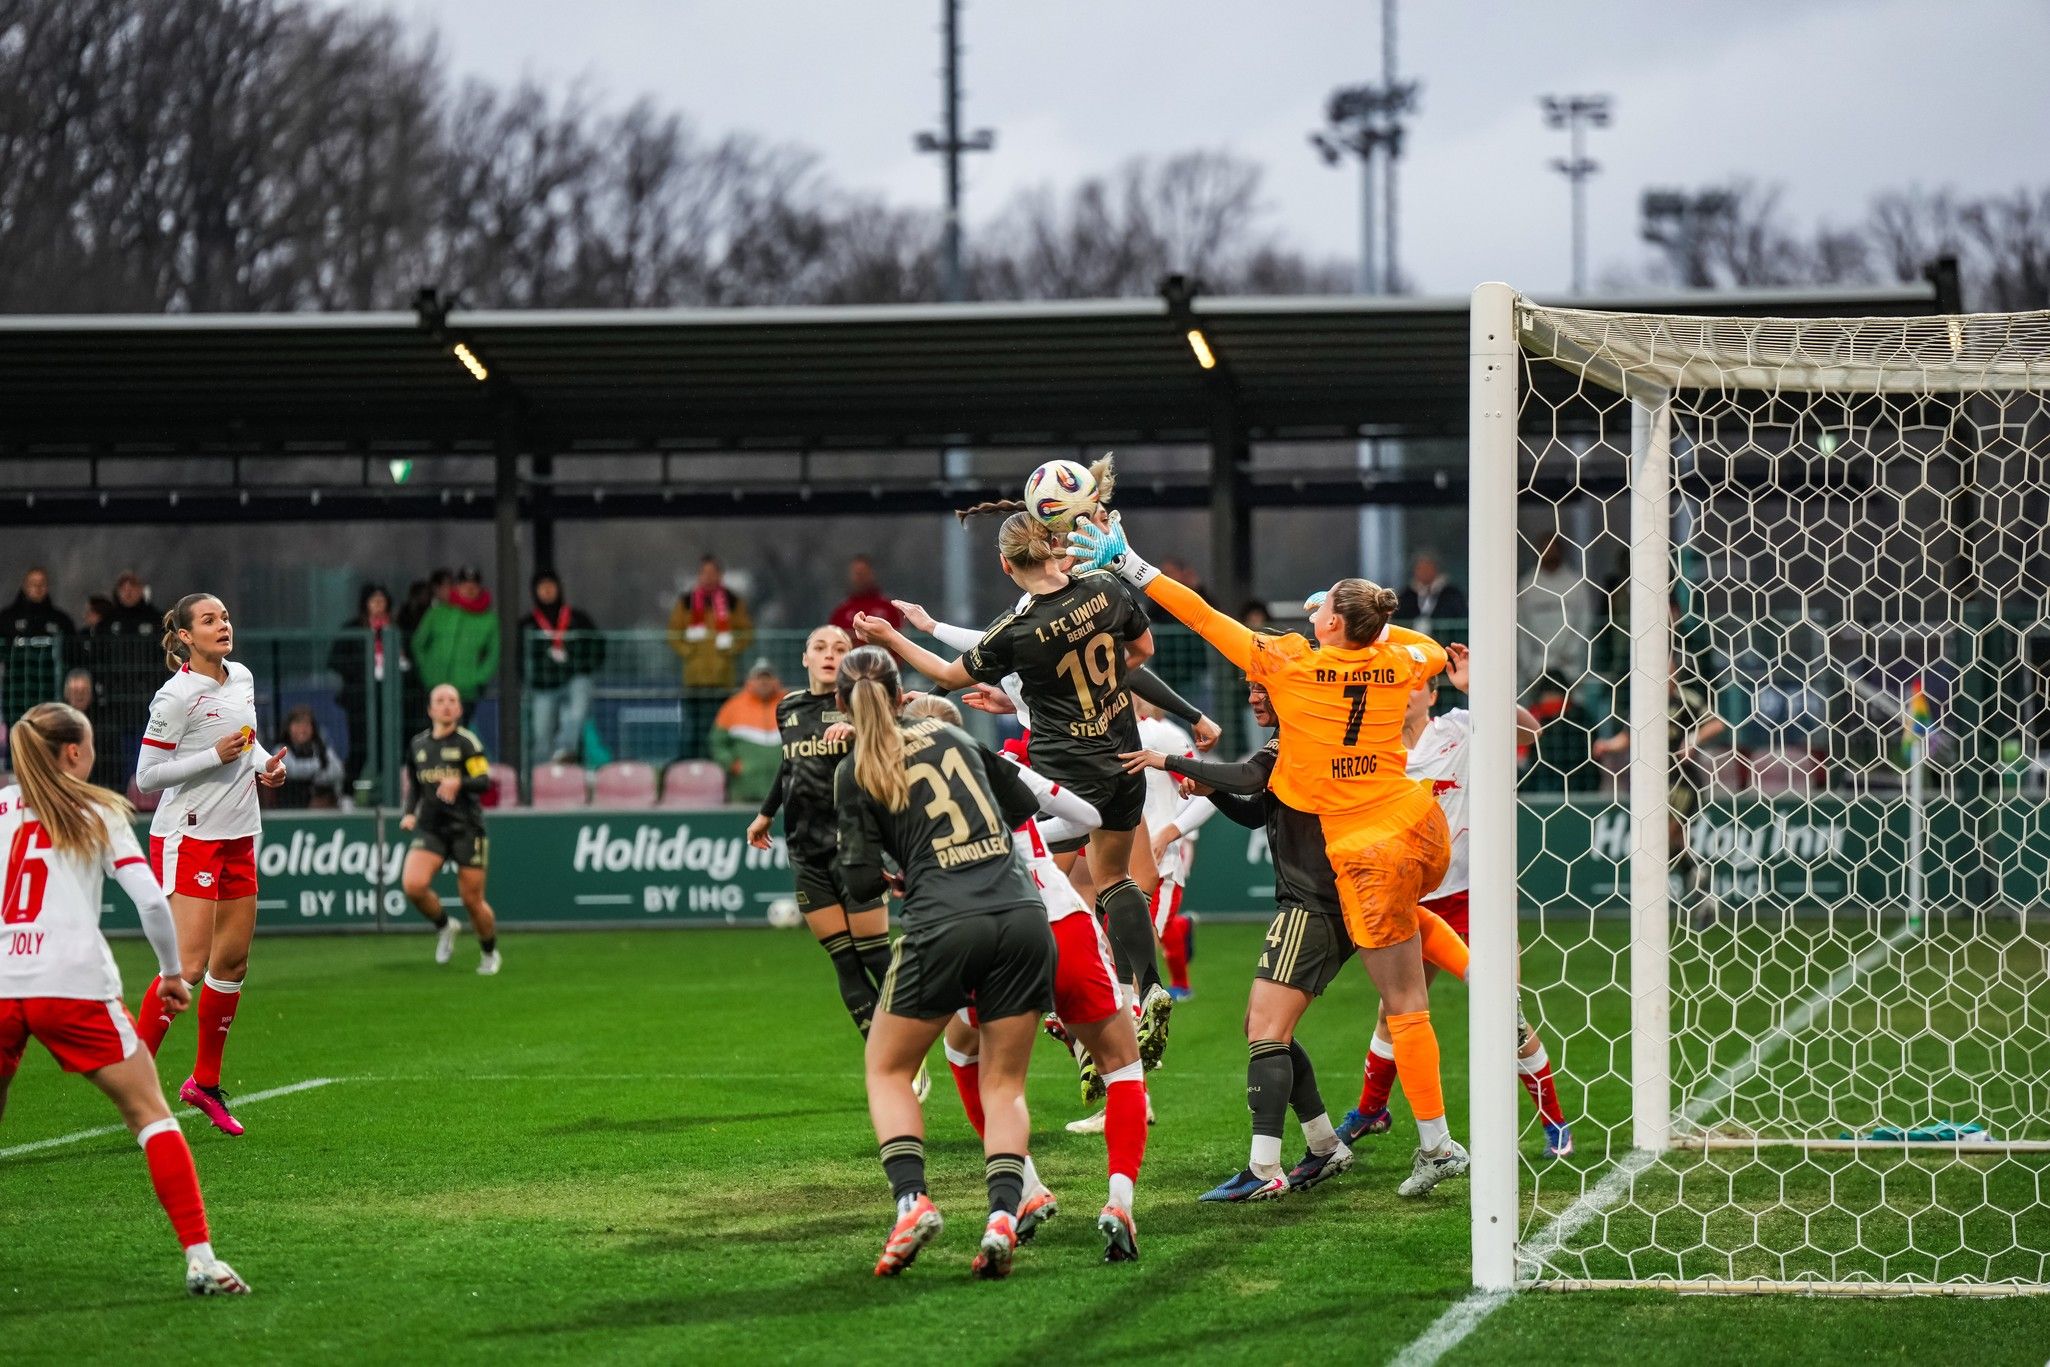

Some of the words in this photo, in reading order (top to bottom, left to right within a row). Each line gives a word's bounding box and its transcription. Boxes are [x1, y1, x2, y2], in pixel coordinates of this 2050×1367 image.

[1035, 627, 1050, 643] 1.
[1050, 617, 1071, 637] FC
[1069, 592, 1109, 626] UNION
[1066, 620, 1096, 643] BERLIN
[1056, 632, 1118, 720] 19
[1316, 669, 1337, 682] RB
[1342, 684, 1368, 747] 7
[1331, 754, 1377, 779] HERZOG
[905, 747, 1000, 851] 31
[573, 823, 742, 881] Holiday
[936, 836, 1010, 869] PAWOLLEK
[1, 820, 52, 925] 6
[300, 889, 336, 917] BY
[643, 886, 681, 912] BY
[8, 932, 44, 956] JOLY
[1265, 912, 1286, 948] 4
